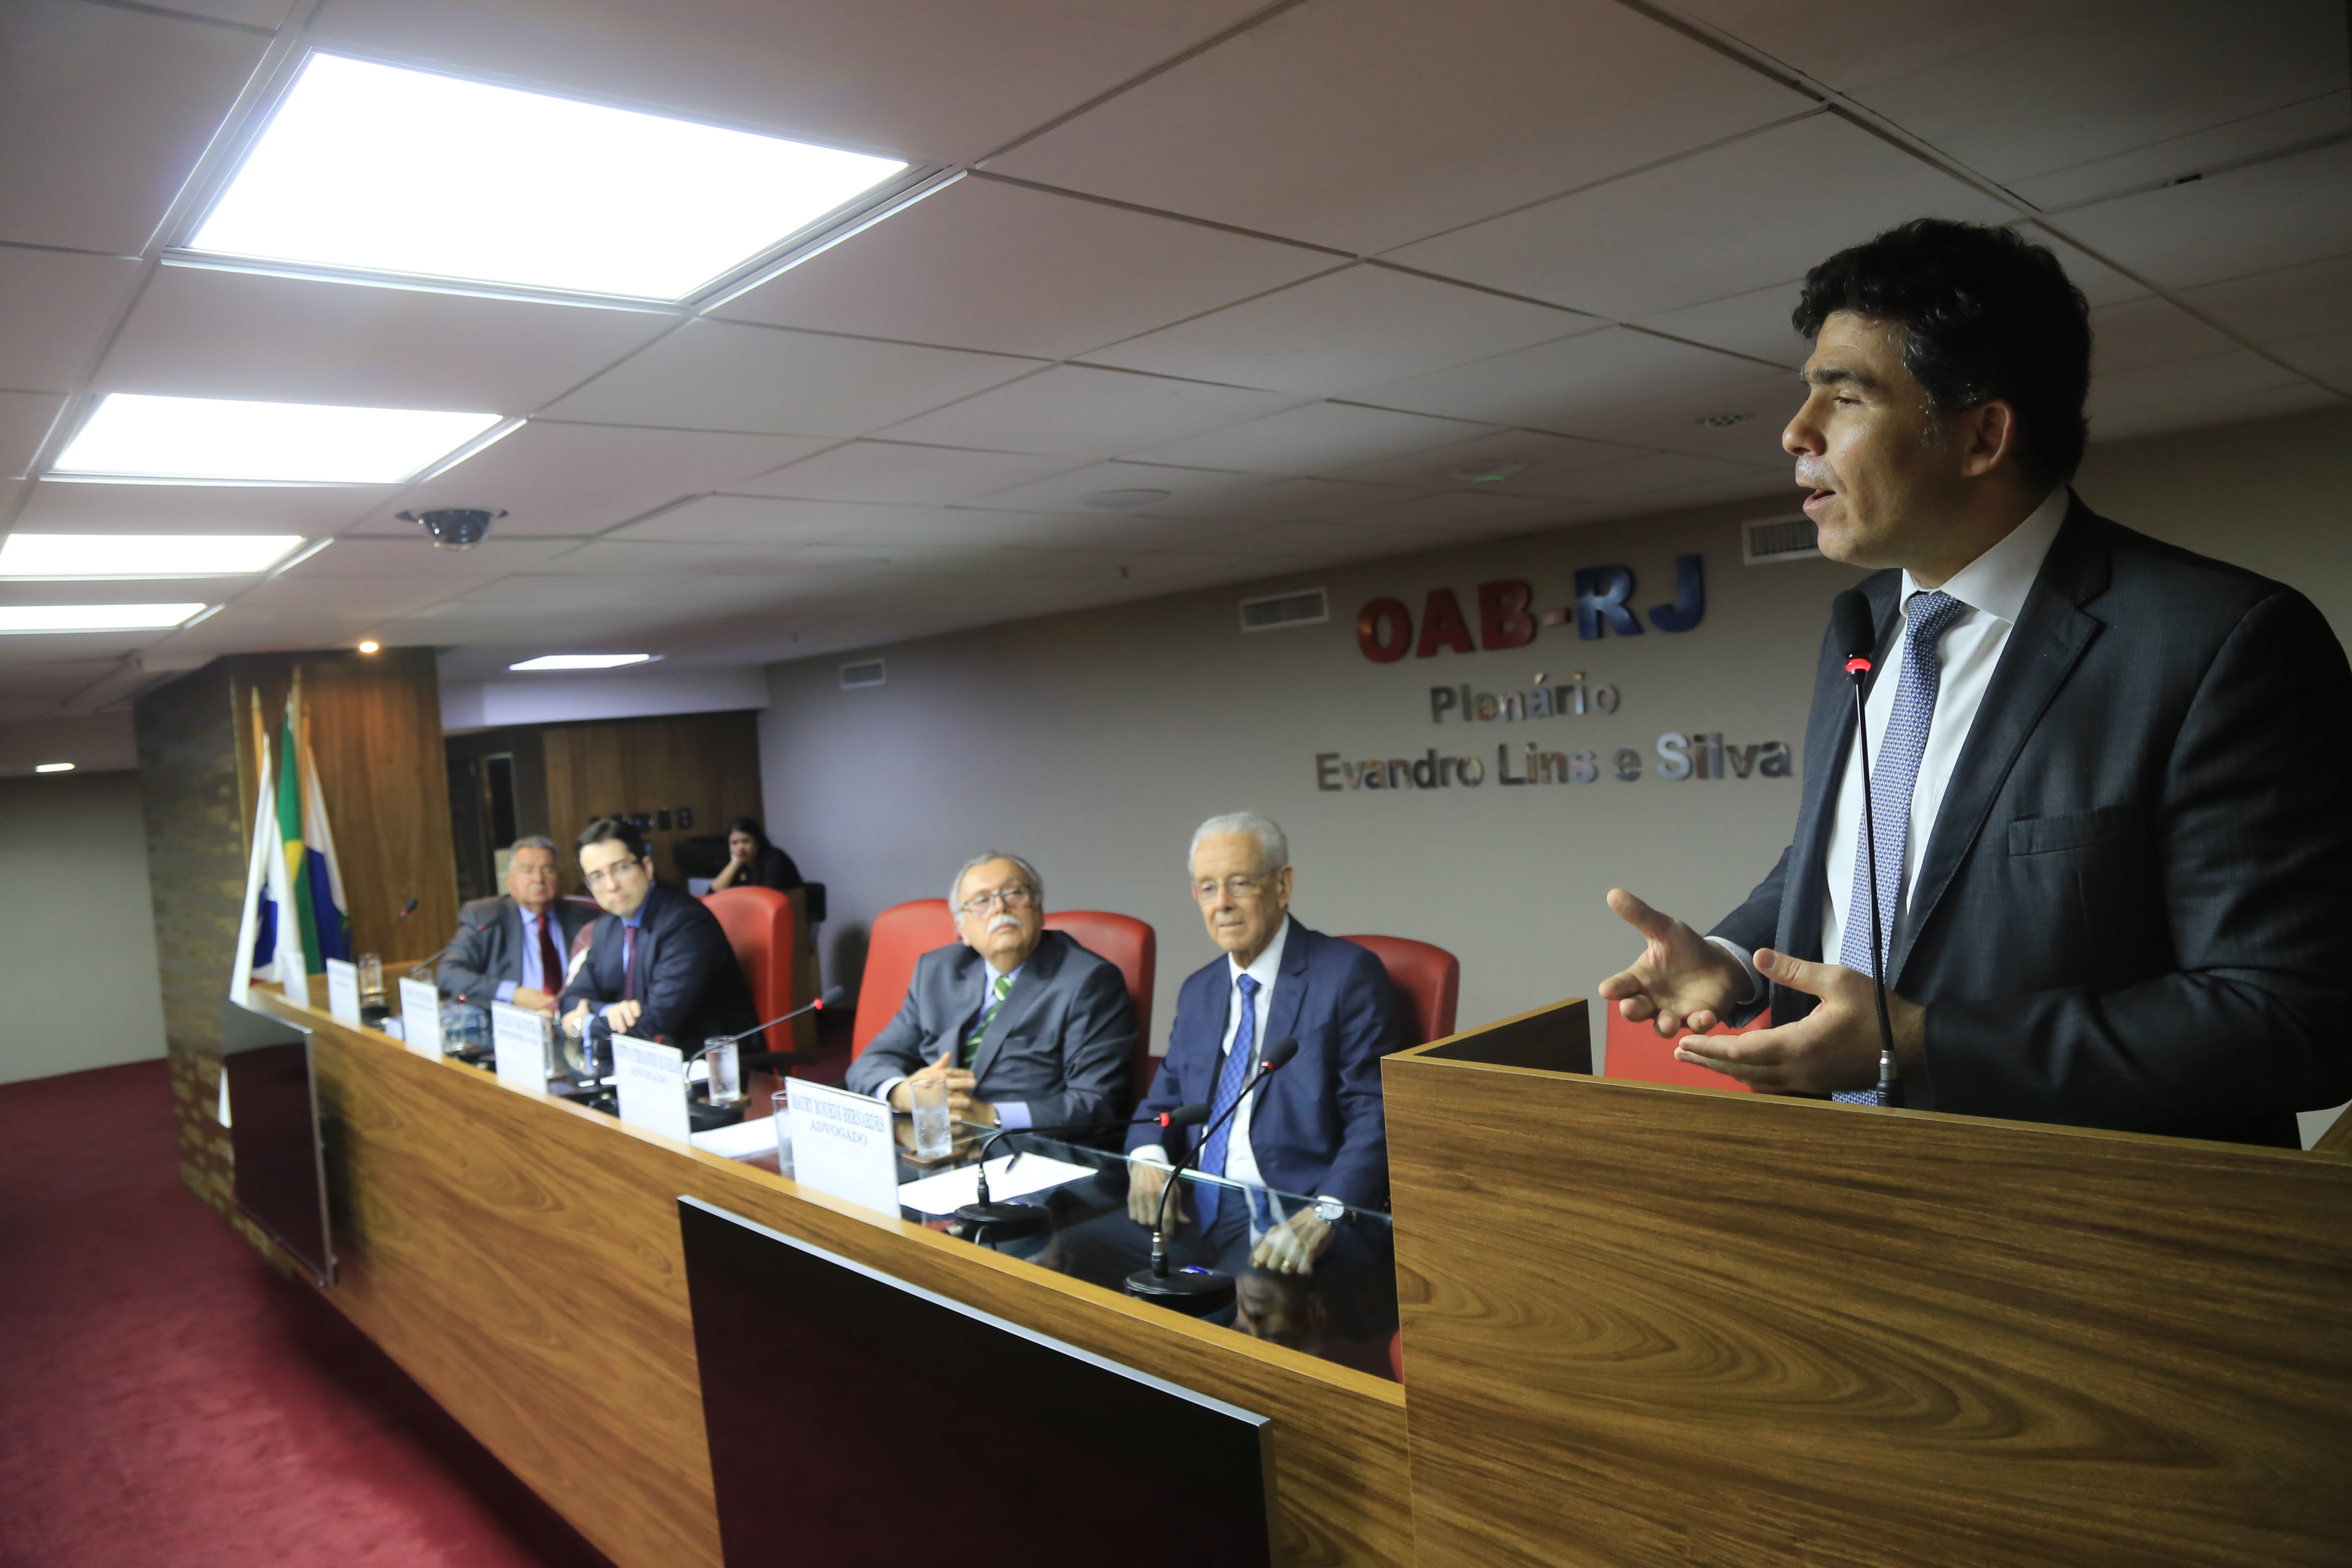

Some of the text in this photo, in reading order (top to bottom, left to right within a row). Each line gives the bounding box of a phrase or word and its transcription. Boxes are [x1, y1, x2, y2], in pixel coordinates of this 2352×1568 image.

[1357, 554, 1706, 663] OAB-RJ
[1431, 671, 1620, 724] Plenário
[1315, 732, 1793, 791] Evandro Lins e Silva
[810, 1120, 867, 1146] ADVOGADO
